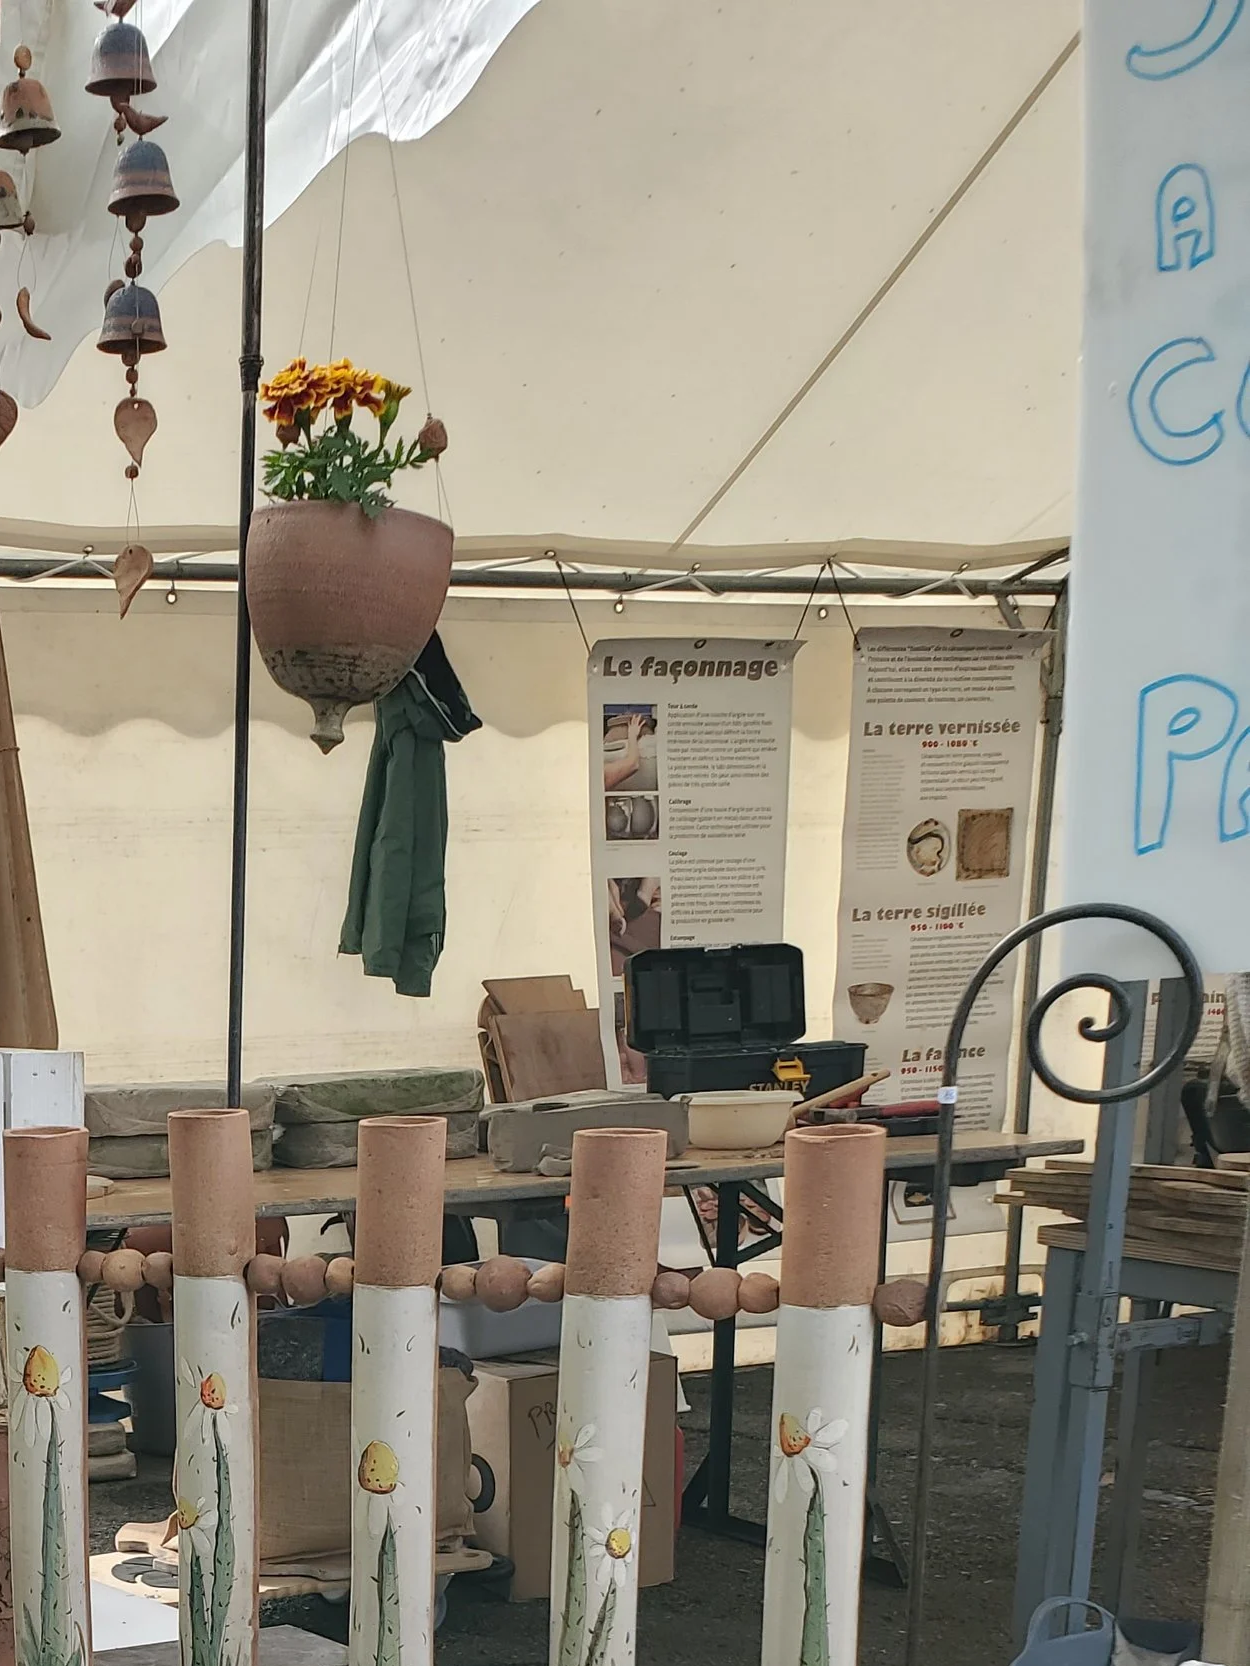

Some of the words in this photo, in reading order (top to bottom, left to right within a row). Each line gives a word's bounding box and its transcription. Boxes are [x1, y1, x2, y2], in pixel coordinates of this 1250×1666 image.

[1127, 336, 1250, 466] C
[602, 655, 633, 677] Le
[640, 655, 779, 685] façonnage
[863, 721, 883, 737] La
[888, 721, 934, 736] terre
[938, 718, 1021, 735] vernissée
[921, 740, 939, 748] 900
[852, 908, 872, 922] La
[877, 907, 923, 921] terre
[926, 902, 987, 920] sigillée
[901, 1049, 921, 1063] La
[925, 1046, 986, 1061] fance
[749, 1080, 810, 1092] STANLEY
